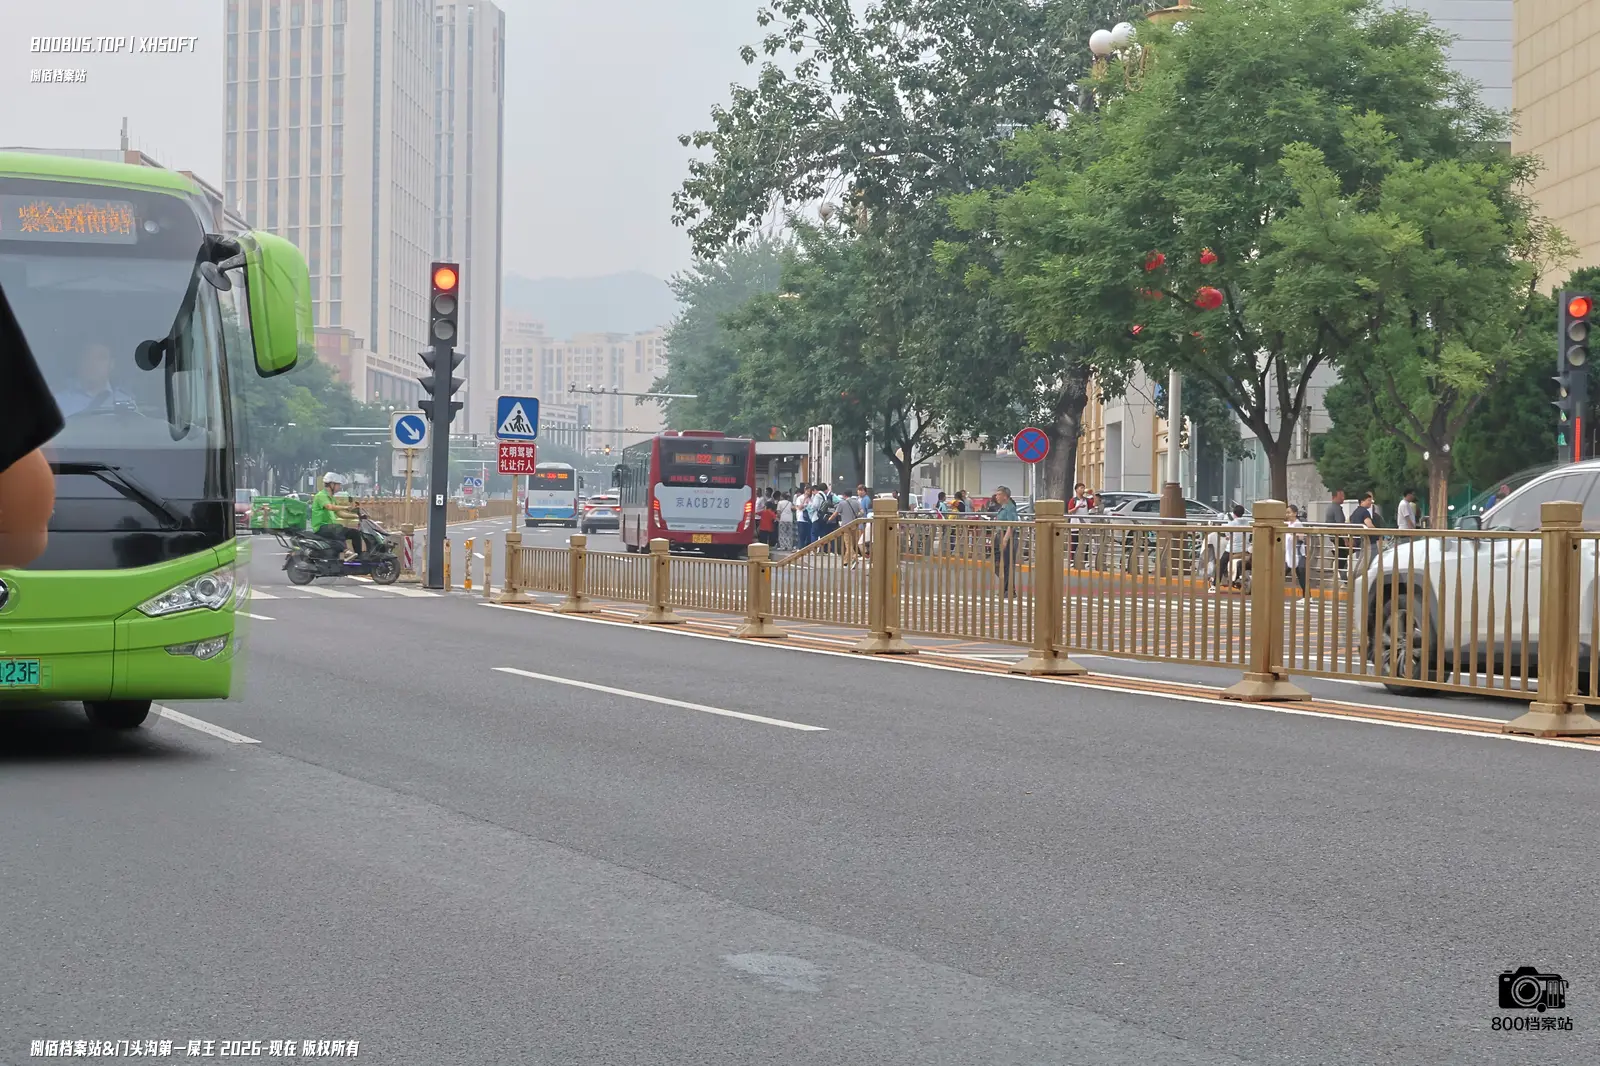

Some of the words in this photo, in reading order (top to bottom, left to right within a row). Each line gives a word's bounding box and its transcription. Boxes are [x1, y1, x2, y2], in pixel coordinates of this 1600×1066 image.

[500, 446, 534, 458] 文明驾驶
[500, 459, 534, 471] 礼让行人
[675, 497, 730, 509] 京ACB728
